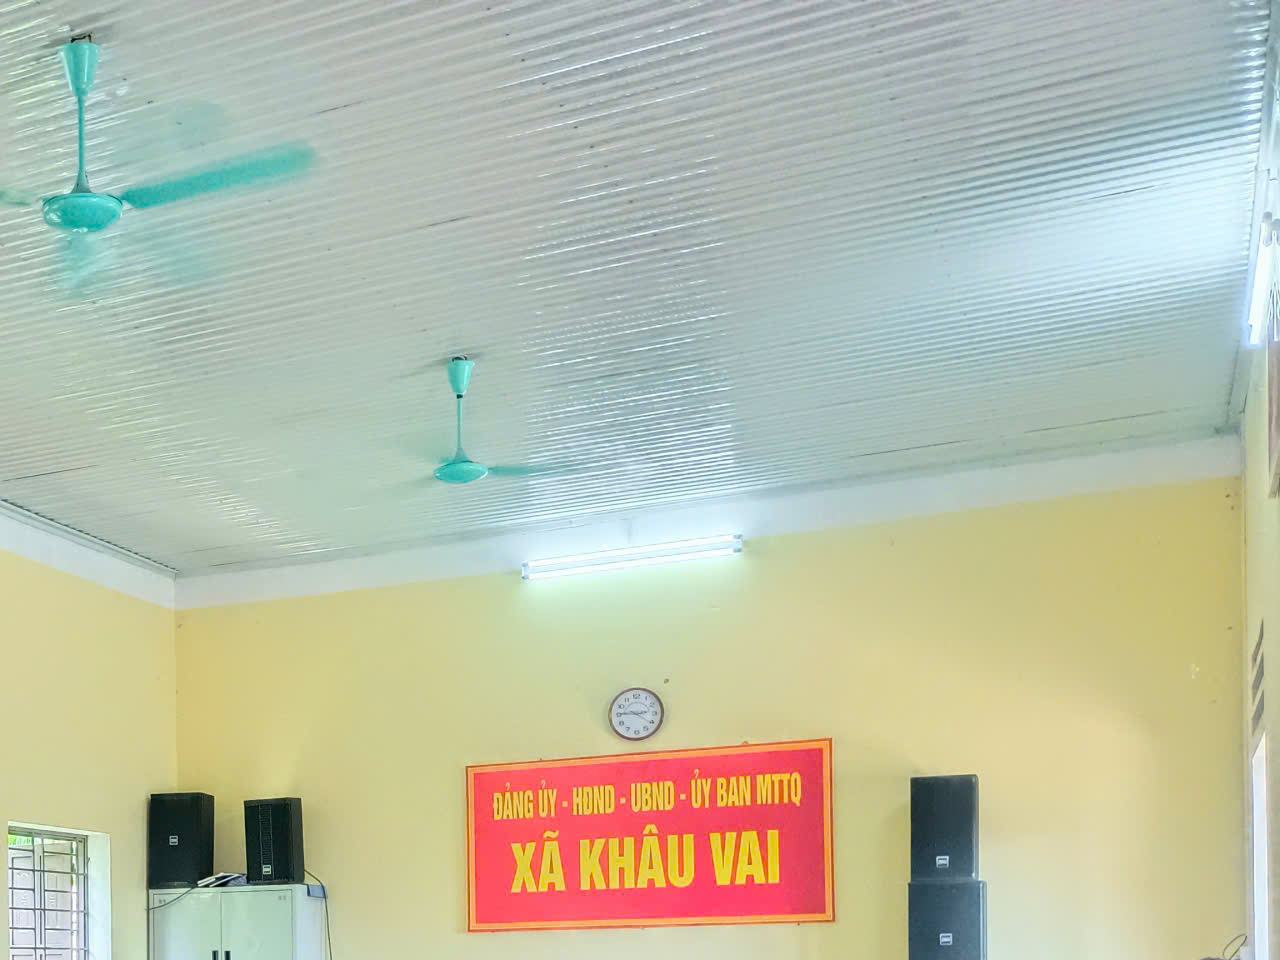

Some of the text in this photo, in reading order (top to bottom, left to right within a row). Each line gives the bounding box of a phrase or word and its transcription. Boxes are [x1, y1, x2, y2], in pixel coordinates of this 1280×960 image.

[493, 782, 534, 821] ĐẢNG
[538, 780, 557, 818] ỦY
[572, 785, 615, 815] HĐND
[631, 781, 675, 812] UBND
[691, 769, 711, 808] ỦY
[717, 776, 751, 807] BAN
[756, 772, 802, 807] MTTQ
[511, 824, 780, 893] XÃ KHÂU VAI
